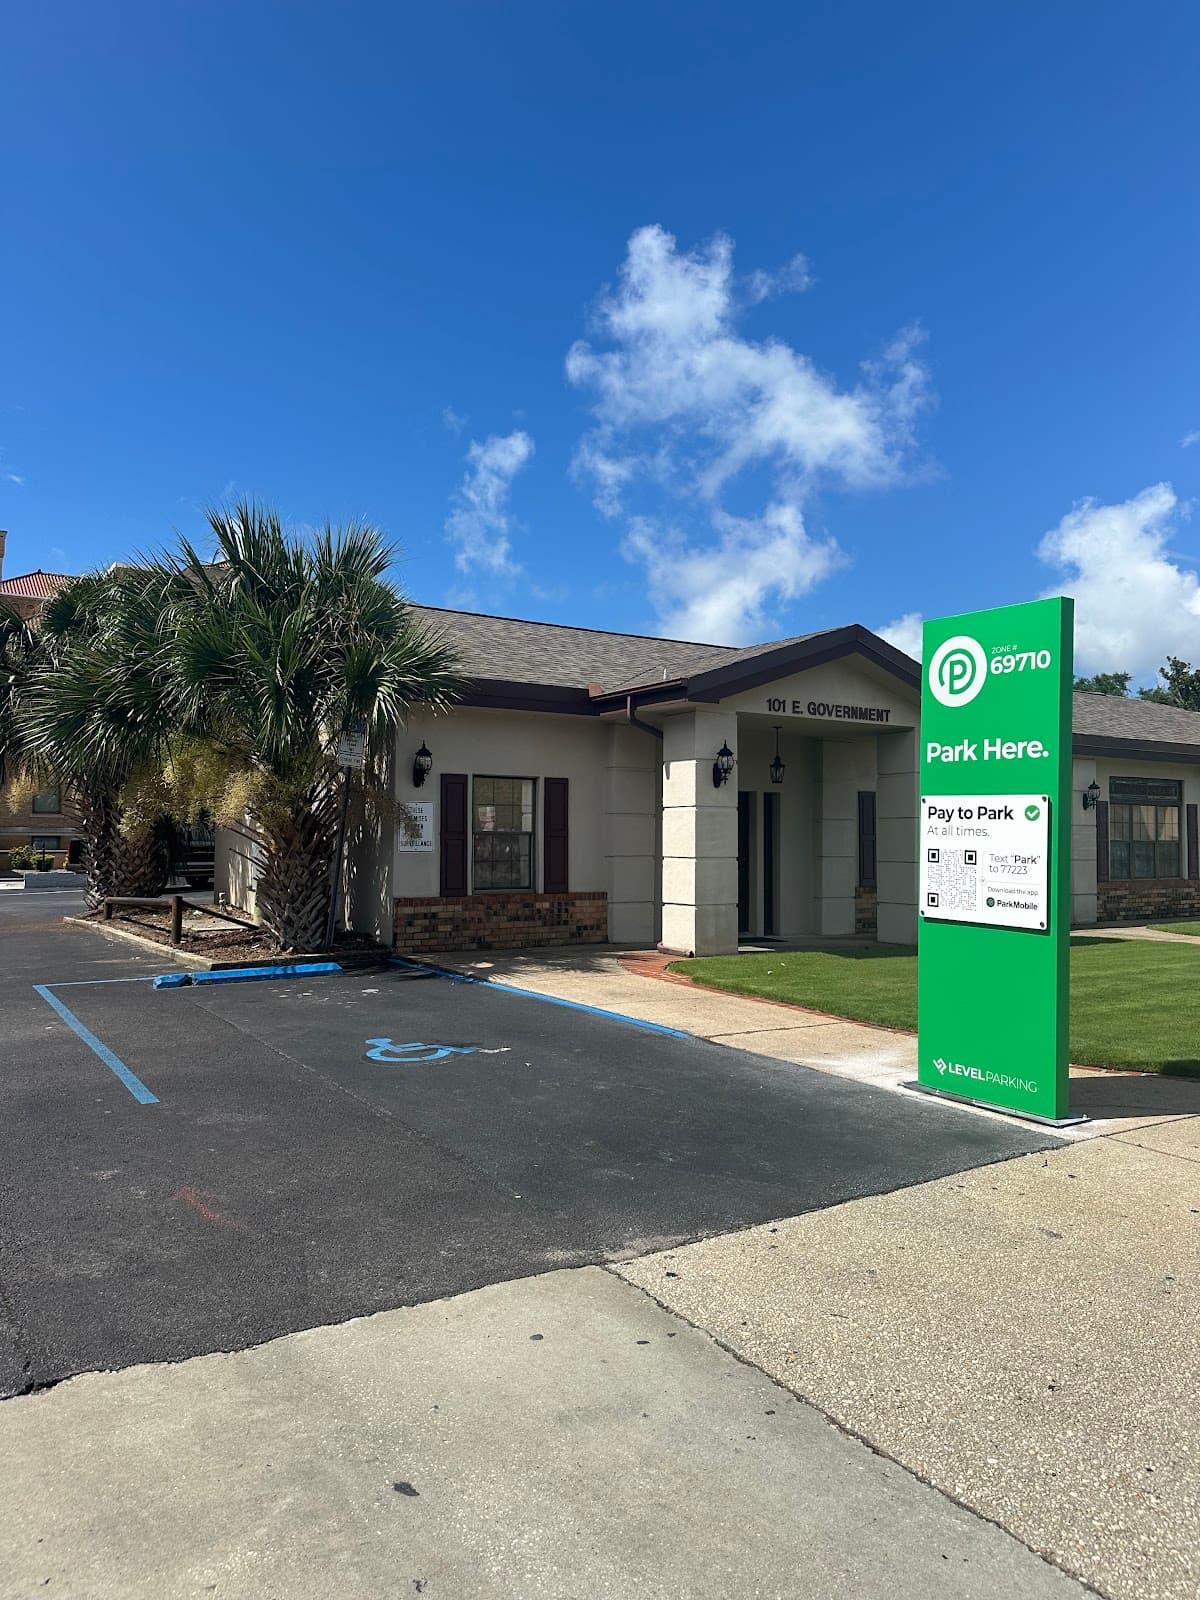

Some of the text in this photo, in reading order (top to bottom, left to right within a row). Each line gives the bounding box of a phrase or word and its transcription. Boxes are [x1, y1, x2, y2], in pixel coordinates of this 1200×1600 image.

[991, 645, 1011, 655] ZONE
[990, 650, 1051, 675] 69710
[766, 698, 891, 722] 101 E. GOVERNMENT
[927, 738, 1049, 763] Park Here.
[928, 805, 1014, 823] Pay to Park
[927, 825, 990, 837] At all times.
[988, 853, 1008, 864] Text
[989, 864, 1028, 875] to 77223
[987, 886, 1016, 894] Download
[996, 899, 1038, 911] ParkMobile
